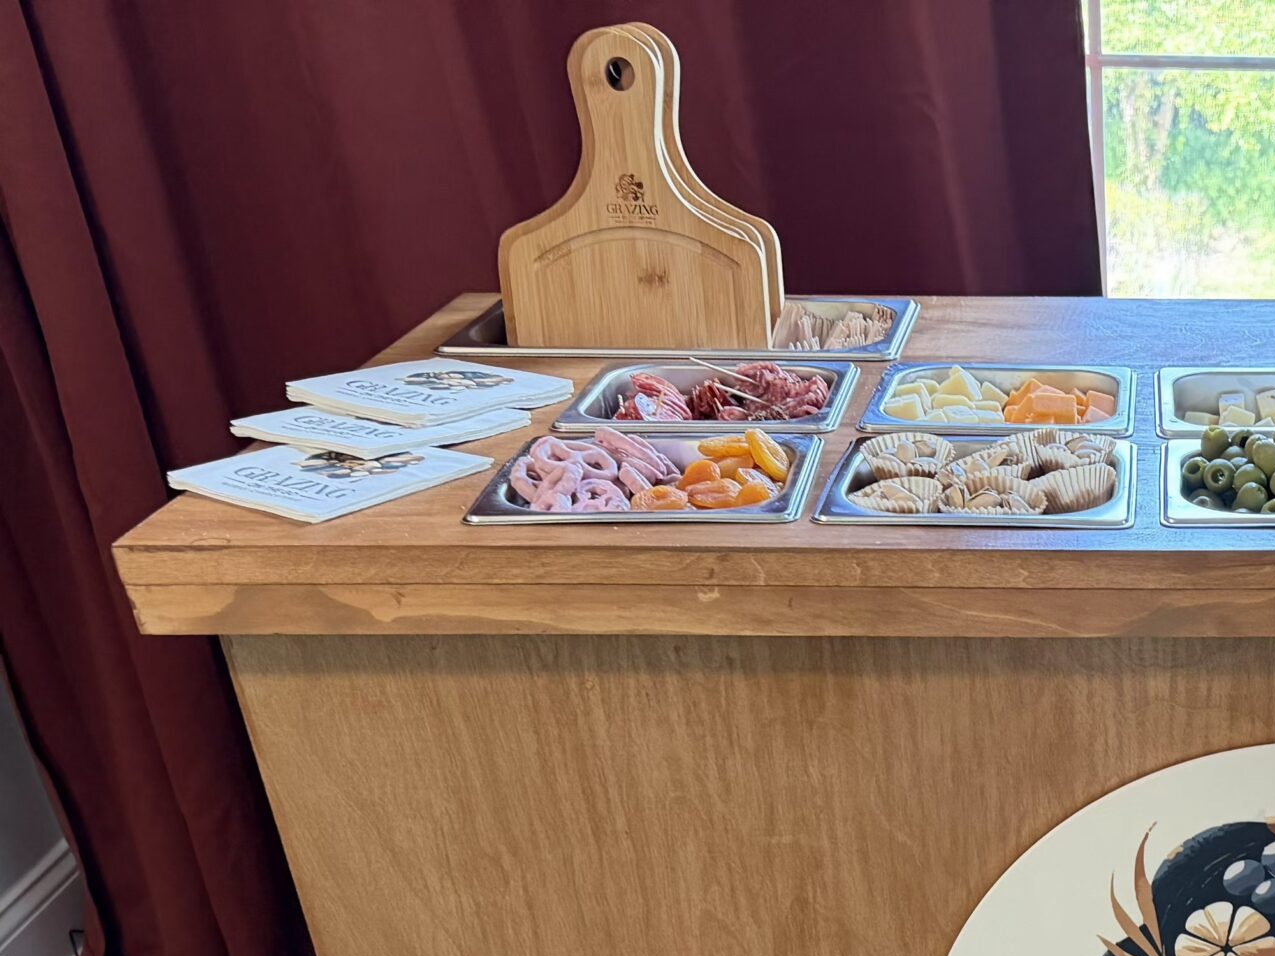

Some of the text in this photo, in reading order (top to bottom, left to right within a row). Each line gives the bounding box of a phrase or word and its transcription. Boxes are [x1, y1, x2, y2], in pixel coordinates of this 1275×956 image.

[606, 203, 659, 216] GRAZING
[345, 379, 458, 406] GRAZING
[293, 415, 404, 439] GRAZING
[233, 465, 357, 499] GRAZING
